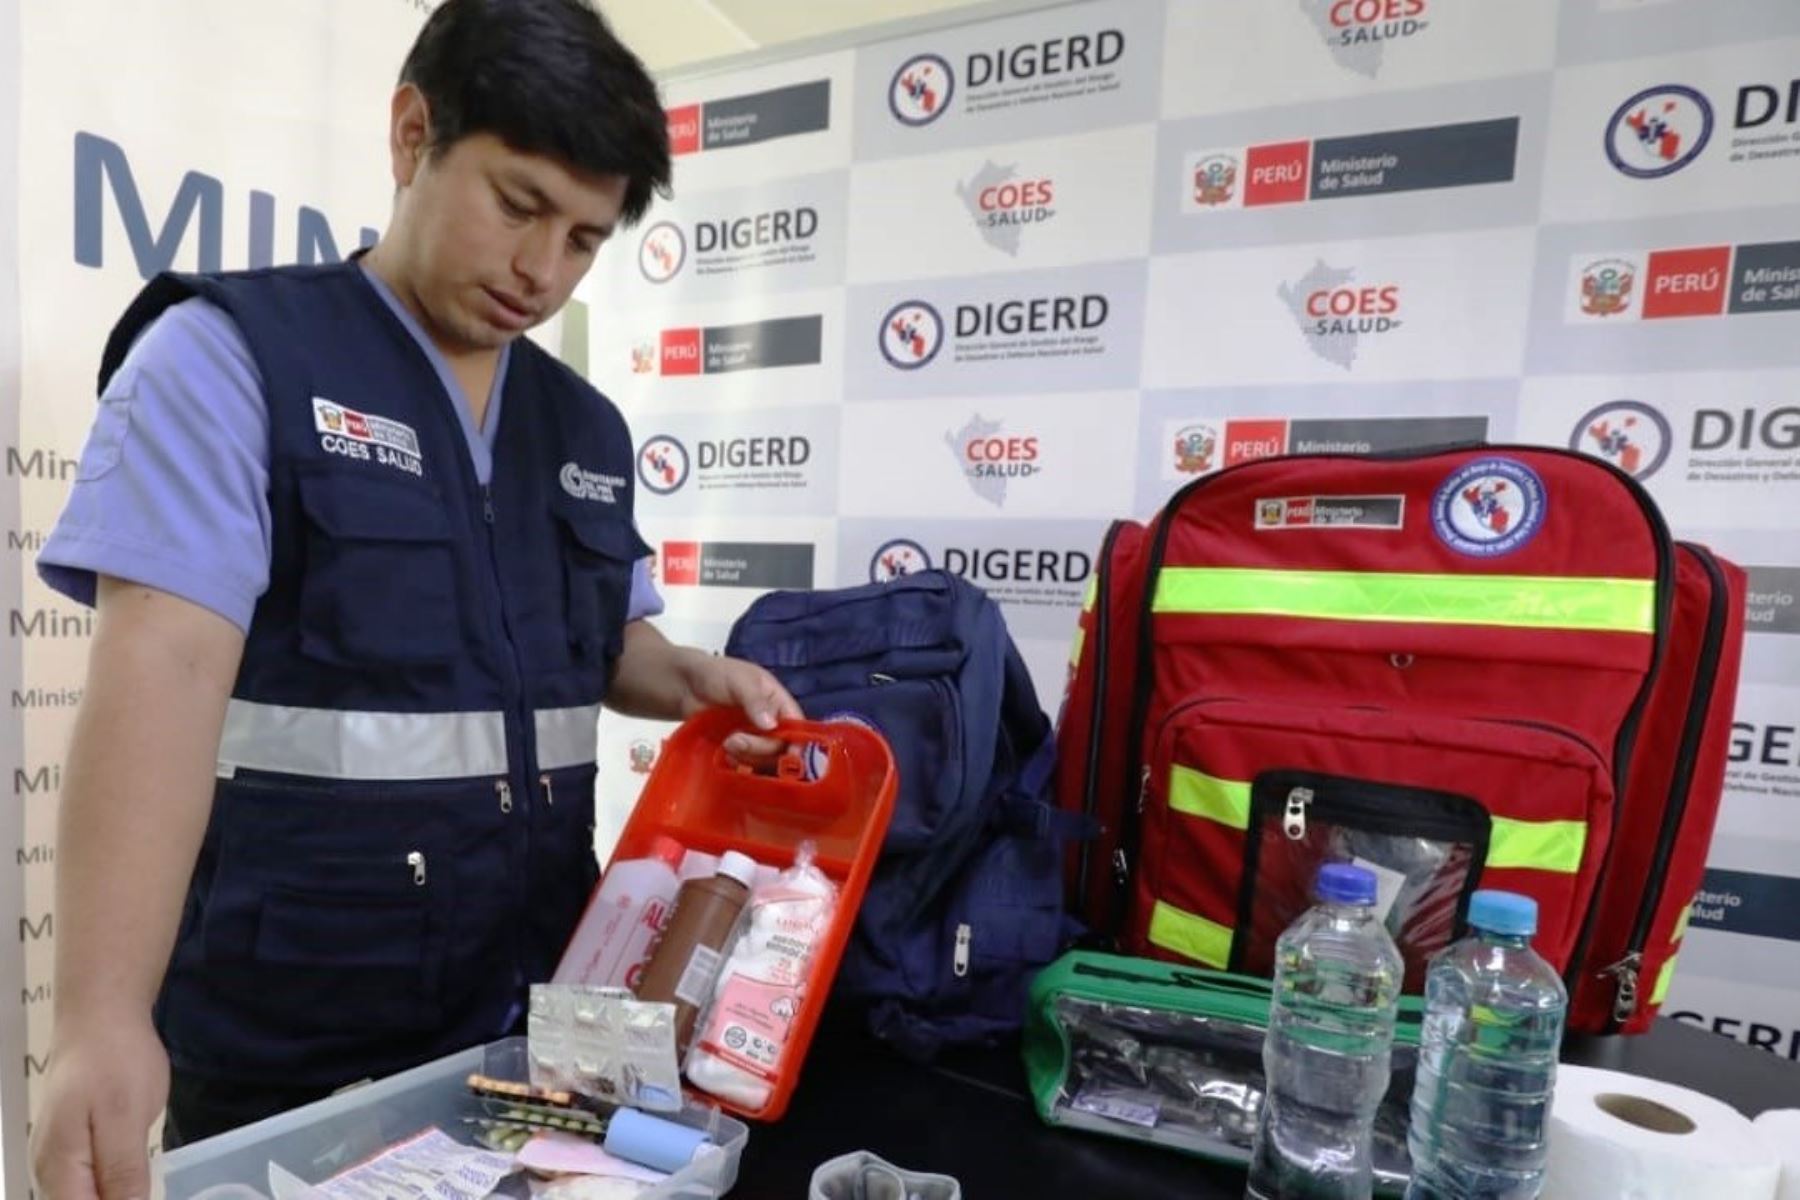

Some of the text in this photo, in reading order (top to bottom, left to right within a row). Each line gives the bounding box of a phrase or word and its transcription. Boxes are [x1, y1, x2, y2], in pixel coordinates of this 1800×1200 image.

[1340, 19, 1416, 46] SALUD
[966, 29, 1126, 88] DIGERD
[1252, 160, 1303, 185] PERÚ
[1320, 154, 1397, 174] Ministerio
[1319, 171, 1384, 190] de Salud
[979, 180, 1054, 212] COES
[695, 207, 818, 252] DIGERD
[987, 207, 1048, 228] SALUD
[1655, 267, 1720, 294] PERÚ
[1741, 286, 1766, 302] de
[1306, 286, 1399, 318] COES
[955, 294, 1109, 338] DIGERD
[1316, 316, 1390, 336] SALUD
[321, 434, 370, 460] COES
[376, 447, 423, 477] SALUD
[697, 436, 811, 469] DIGERD
[966, 437, 1039, 462] COES
[1231, 436, 1280, 459] PERÚ
[1296, 439, 1371, 453] Ministerio
[975, 463, 1033, 477] SALUD
[944, 548, 1091, 582] DIGERD
[1727, 722, 1800, 766] GE
